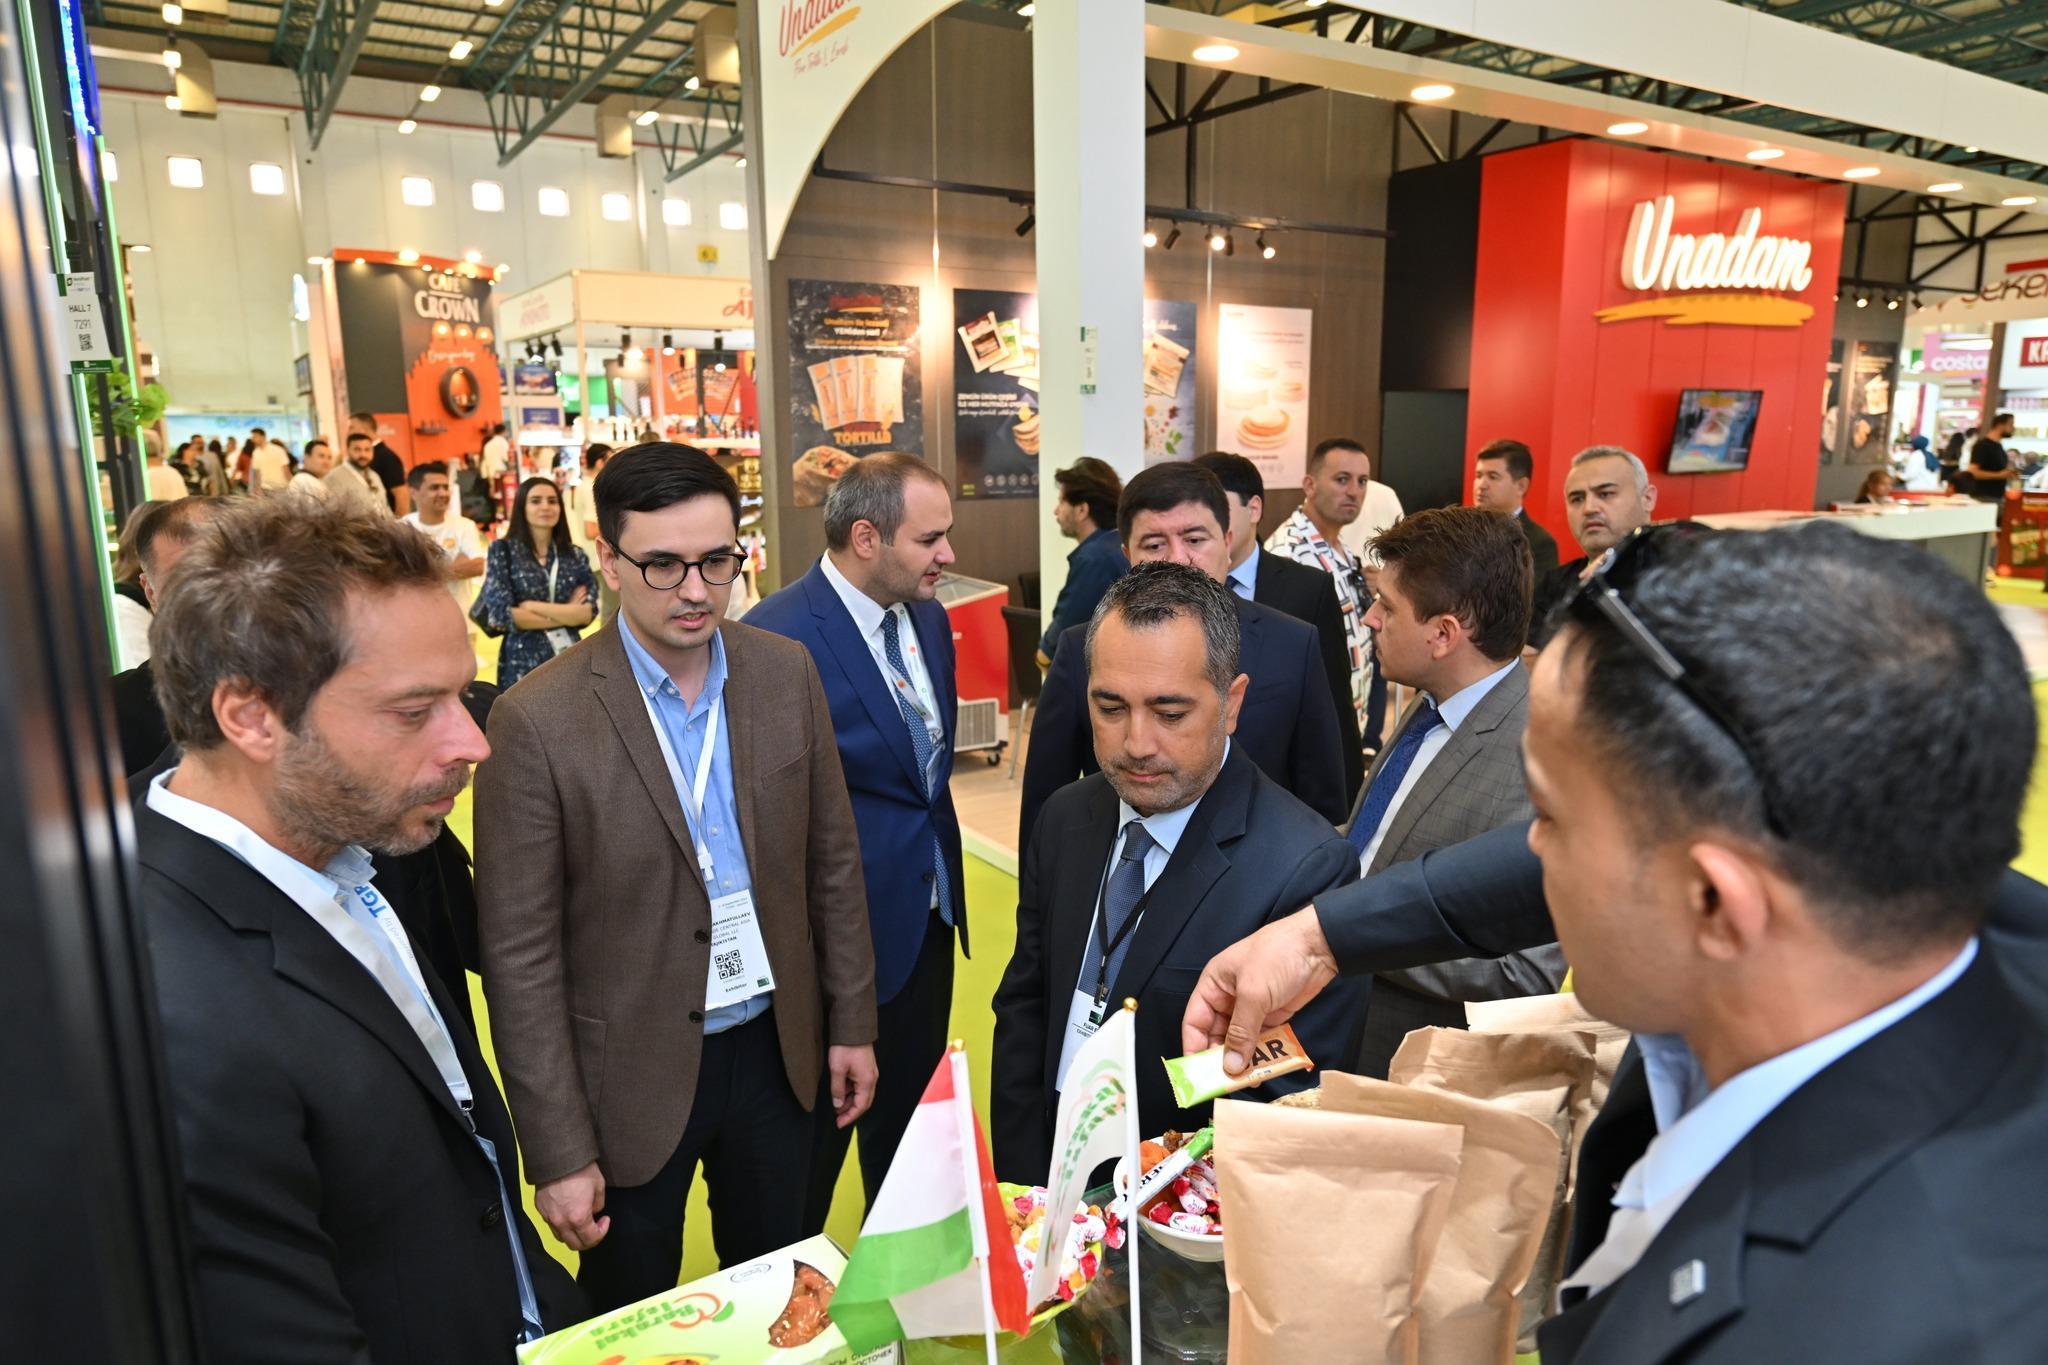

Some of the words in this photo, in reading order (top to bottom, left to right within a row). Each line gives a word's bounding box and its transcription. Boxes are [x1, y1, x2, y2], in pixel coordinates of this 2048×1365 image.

[1621, 194, 1813, 292] Unadam
[68, 304, 86, 313] HALL
[86, 304, 92, 312] 7
[414, 290, 480, 323] CROWN
[1249, 1038, 1289, 1067] AR
